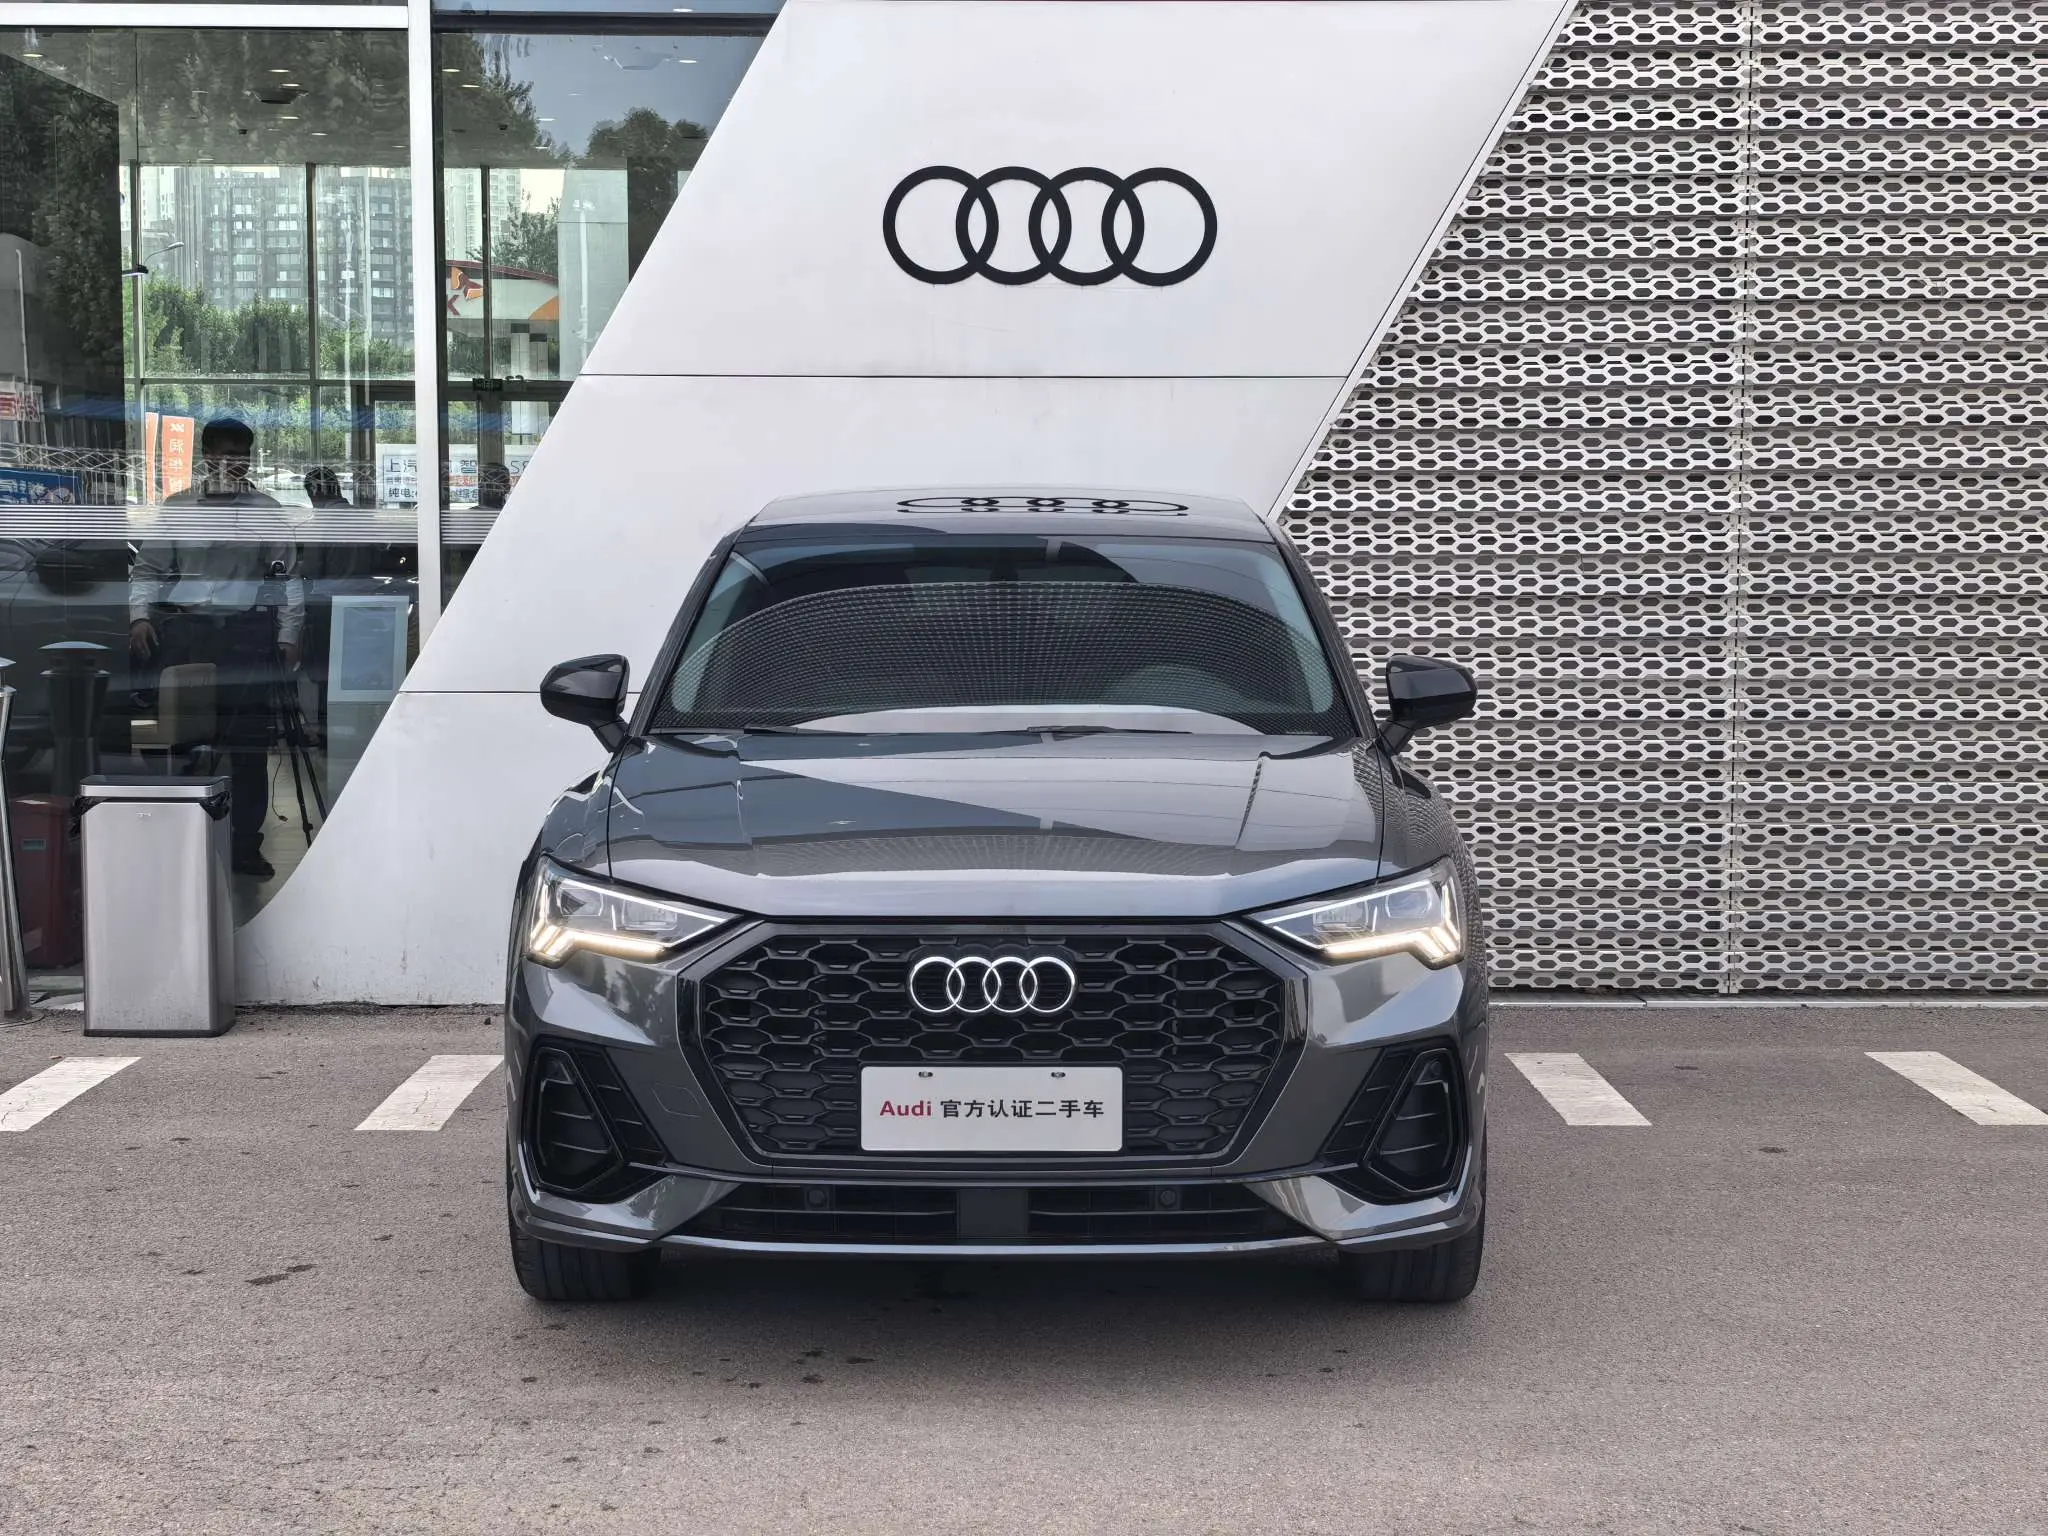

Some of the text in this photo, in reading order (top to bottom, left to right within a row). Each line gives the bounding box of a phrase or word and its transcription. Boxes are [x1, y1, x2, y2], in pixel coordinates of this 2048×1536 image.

[880, 1099, 1105, 1118] Audi 官方认证二手车
